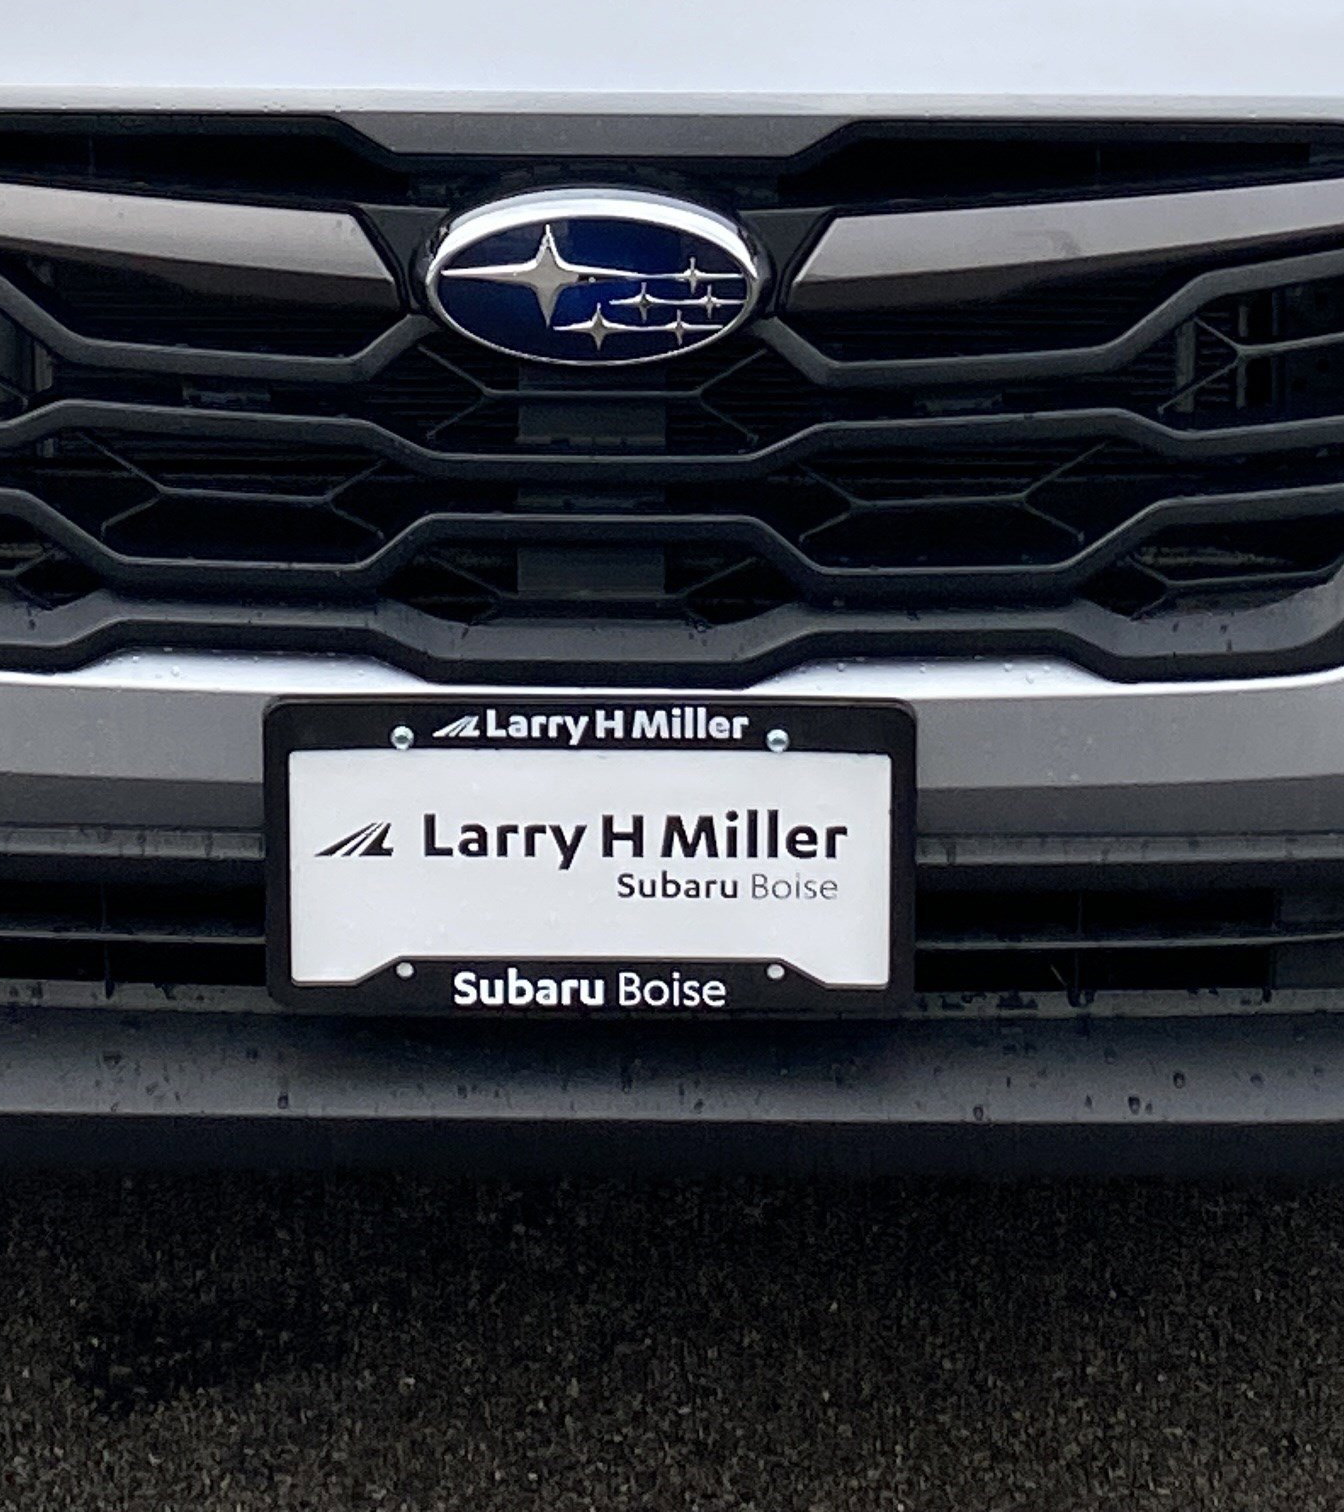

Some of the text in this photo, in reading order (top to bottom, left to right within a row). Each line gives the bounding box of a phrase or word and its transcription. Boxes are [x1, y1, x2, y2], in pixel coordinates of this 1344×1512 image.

[486, 706, 750, 746] Larry H Miller
[423, 808, 848, 870] Larry H Miller
[617, 870, 839, 900] Subaru Boise
[453, 967, 726, 1007] Subaru Boise
